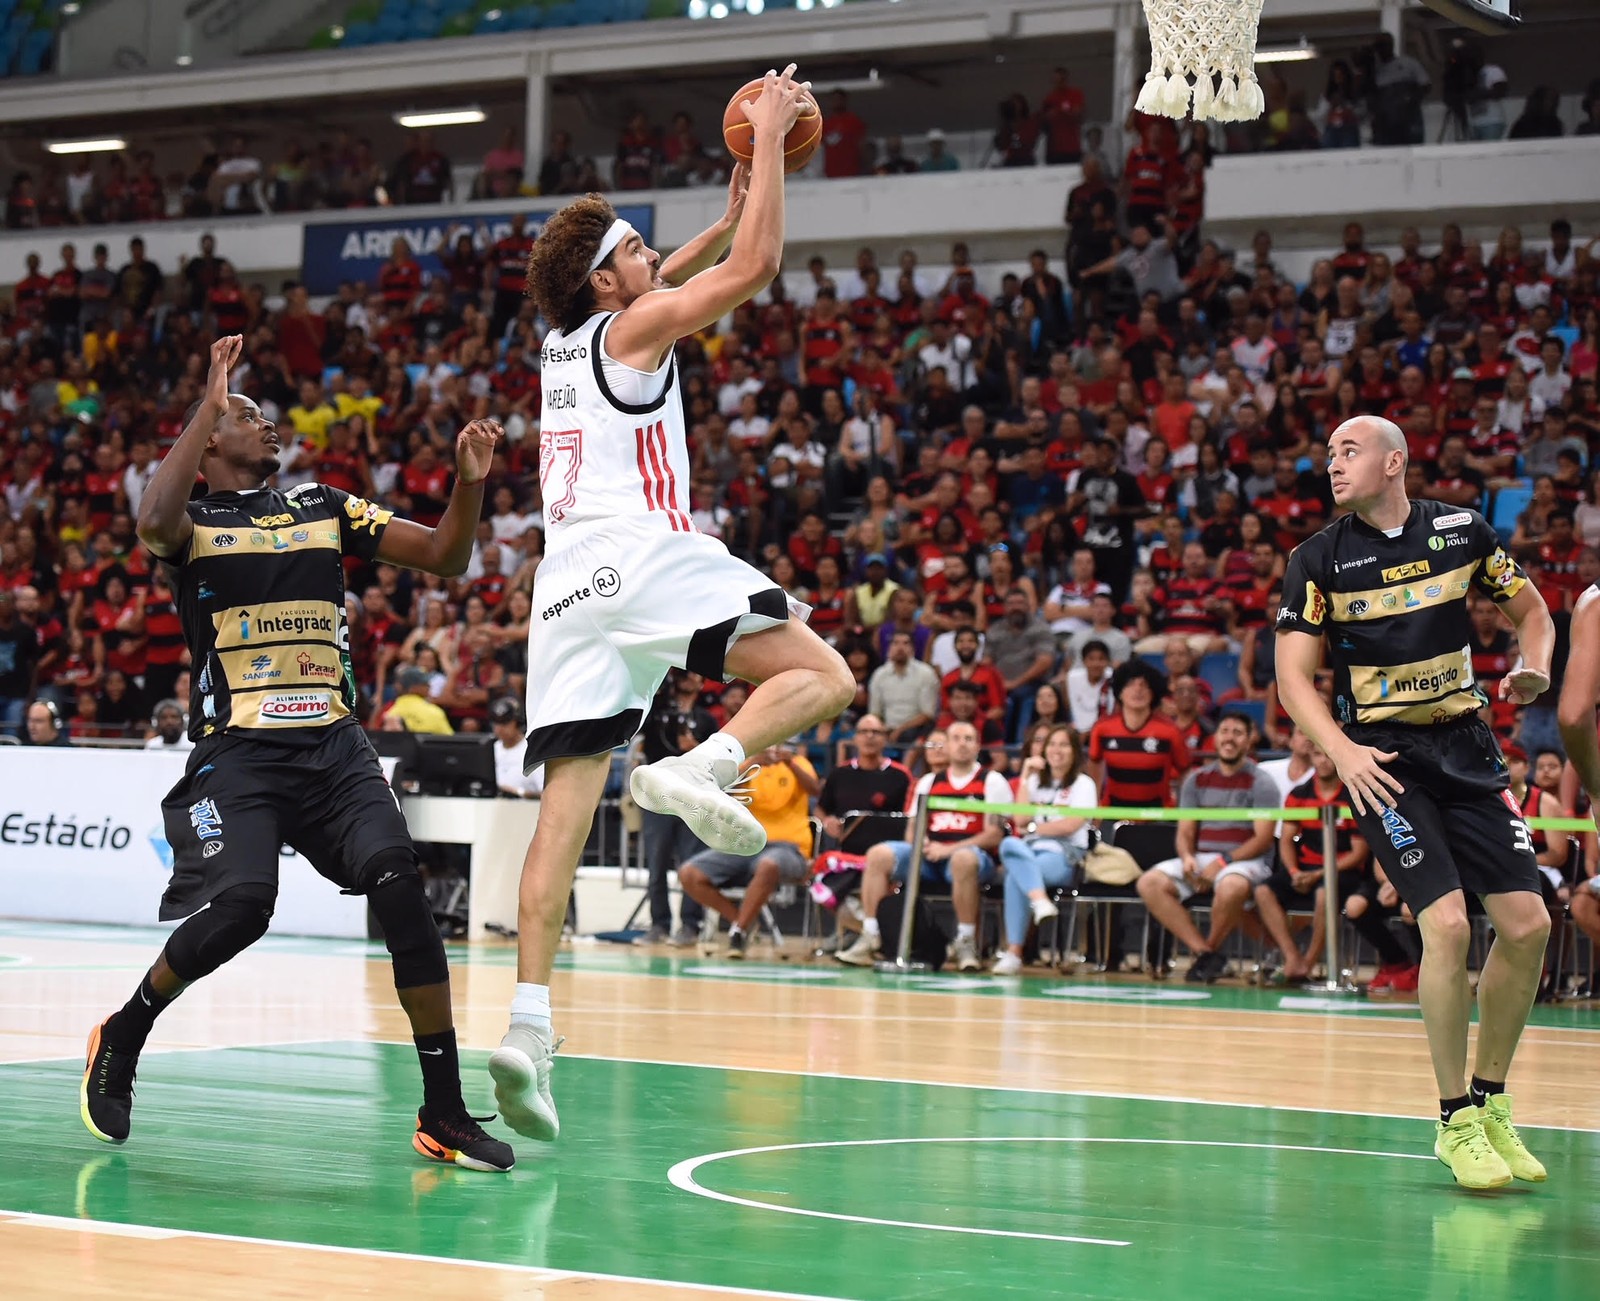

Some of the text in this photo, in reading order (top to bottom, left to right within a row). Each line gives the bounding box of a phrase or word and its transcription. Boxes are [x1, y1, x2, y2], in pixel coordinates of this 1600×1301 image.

[541, 573, 616, 621] esporte RJ
[242, 670, 282, 681] SANEPAR
[262, 702, 328, 713] Coamo
[1, 813, 131, 849] Estácio
